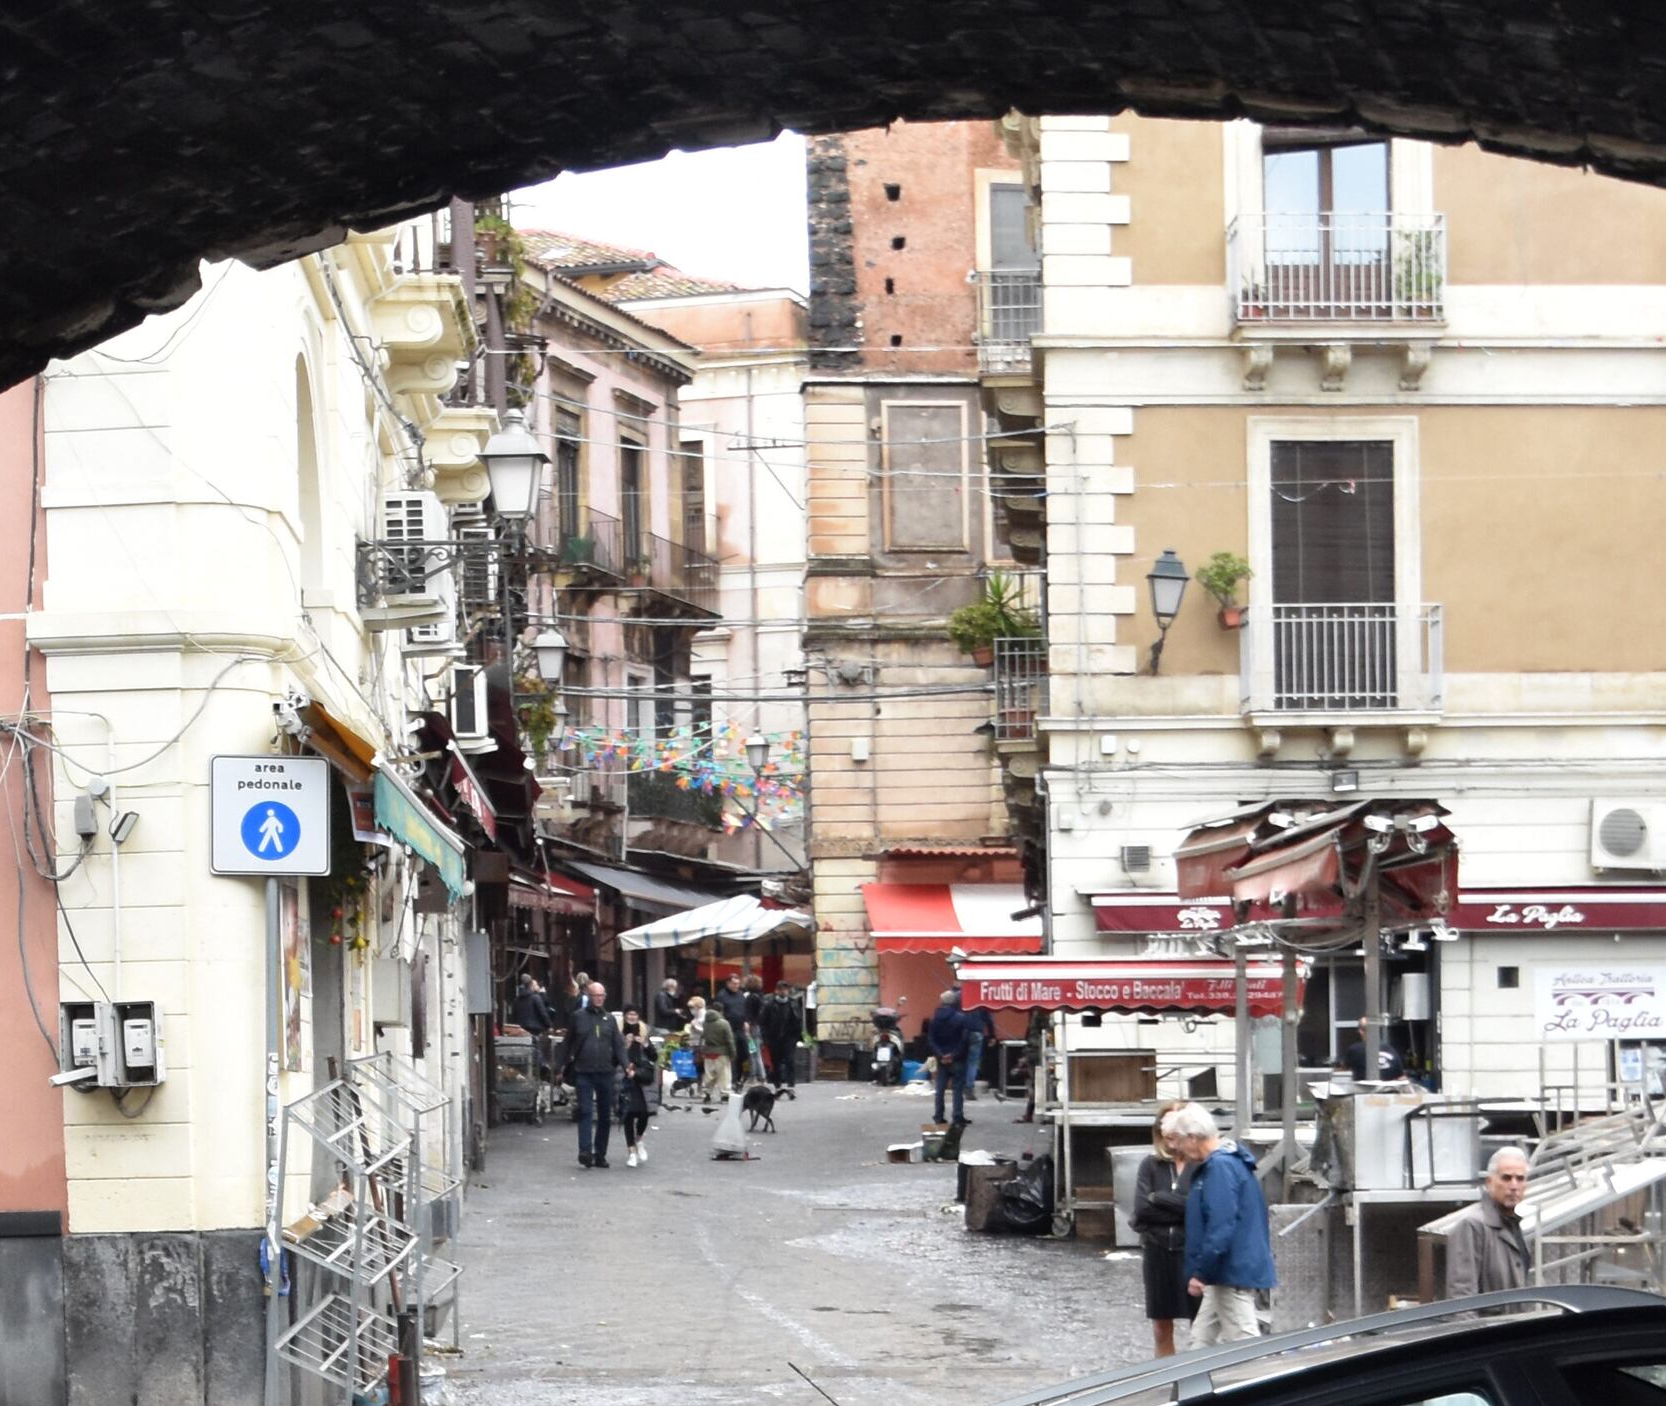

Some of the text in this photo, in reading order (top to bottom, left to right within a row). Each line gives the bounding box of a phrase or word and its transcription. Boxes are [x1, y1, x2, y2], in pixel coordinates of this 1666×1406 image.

[254, 764, 285, 773] area
[237, 779, 303, 791] pedonale
[1486, 904, 1585, 929] La Paglia
[980, 981, 1013, 1001] Frutti
[1016, 981, 1028, 1000] di
[1031, 982, 1061, 1000] Mare
[1075, 980, 1119, 1000] Stocco
[1122, 984, 1131, 1000] e
[1543, 1008, 1662, 1032] La Paglia
